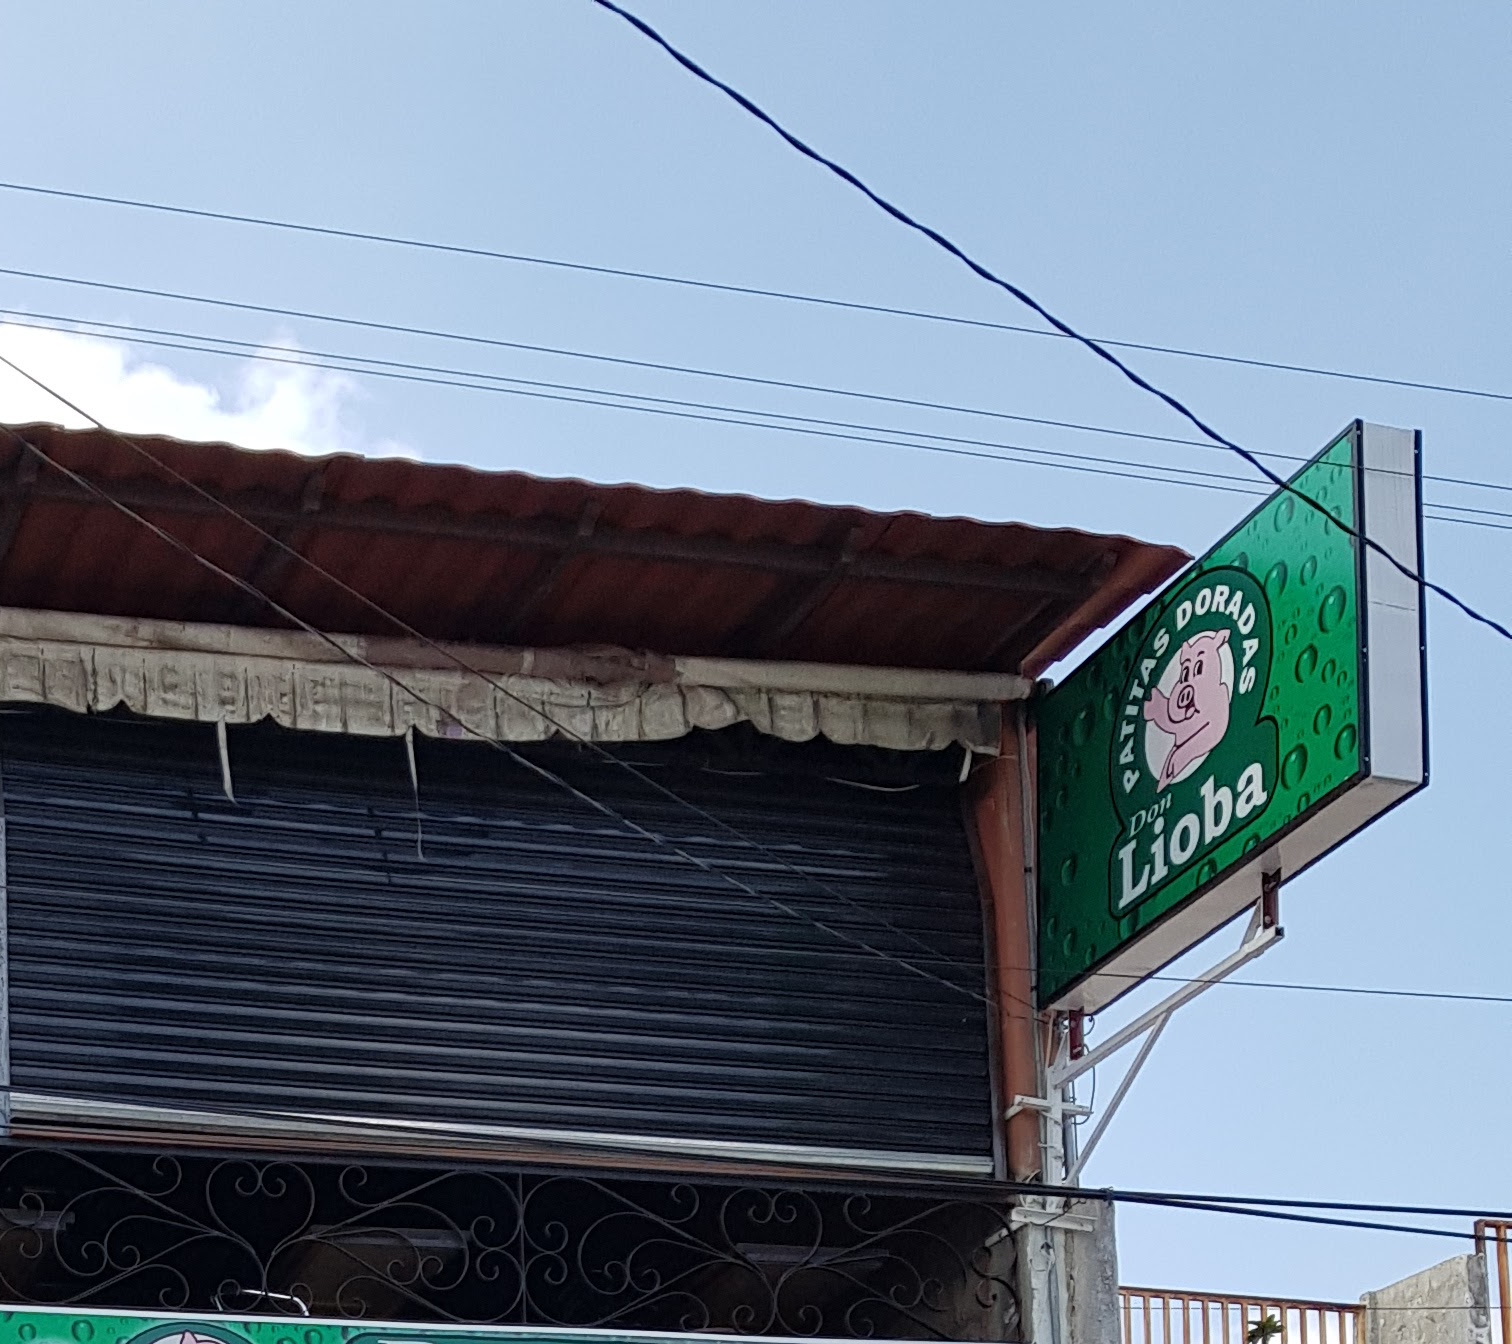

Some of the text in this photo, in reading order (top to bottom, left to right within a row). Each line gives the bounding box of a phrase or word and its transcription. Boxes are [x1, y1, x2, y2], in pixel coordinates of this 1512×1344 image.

[1119, 585, 1260, 794] PATITAS DORADAS
[1118, 762, 1268, 910] Lioba
[1129, 793, 1172, 837] Don
